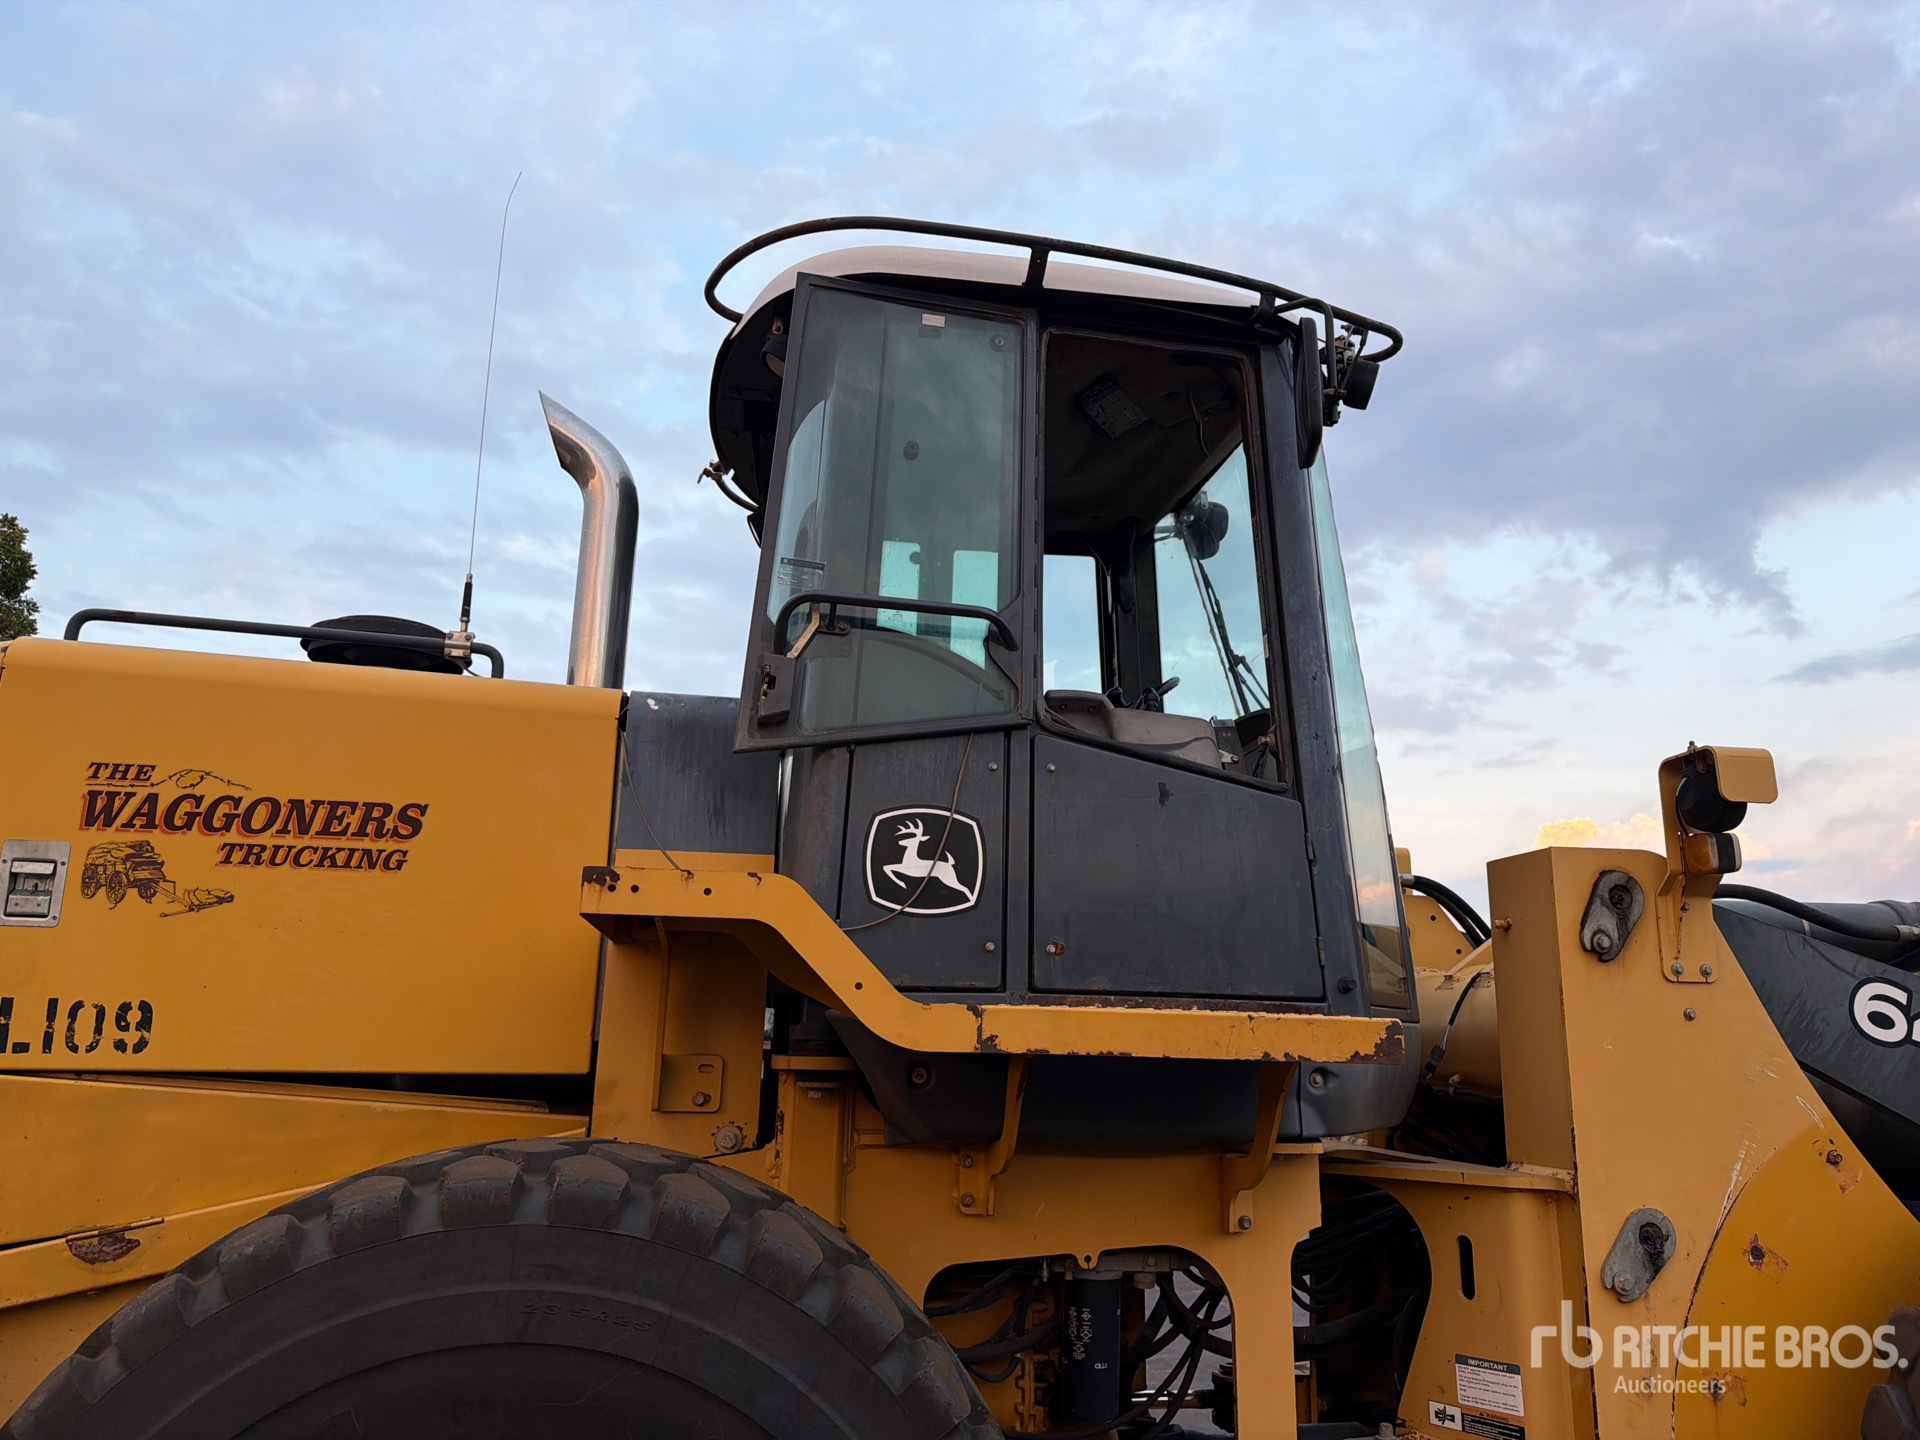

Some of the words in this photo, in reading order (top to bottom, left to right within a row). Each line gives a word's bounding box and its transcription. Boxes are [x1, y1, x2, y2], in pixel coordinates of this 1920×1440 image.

[86, 762, 156, 782] THE
[79, 790, 430, 842] WAGGONERS
[215, 843, 408, 872] TRUCKING
[1852, 981, 1920, 1045] 6
[1467, 1358, 1508, 1372] IMPORTANT
